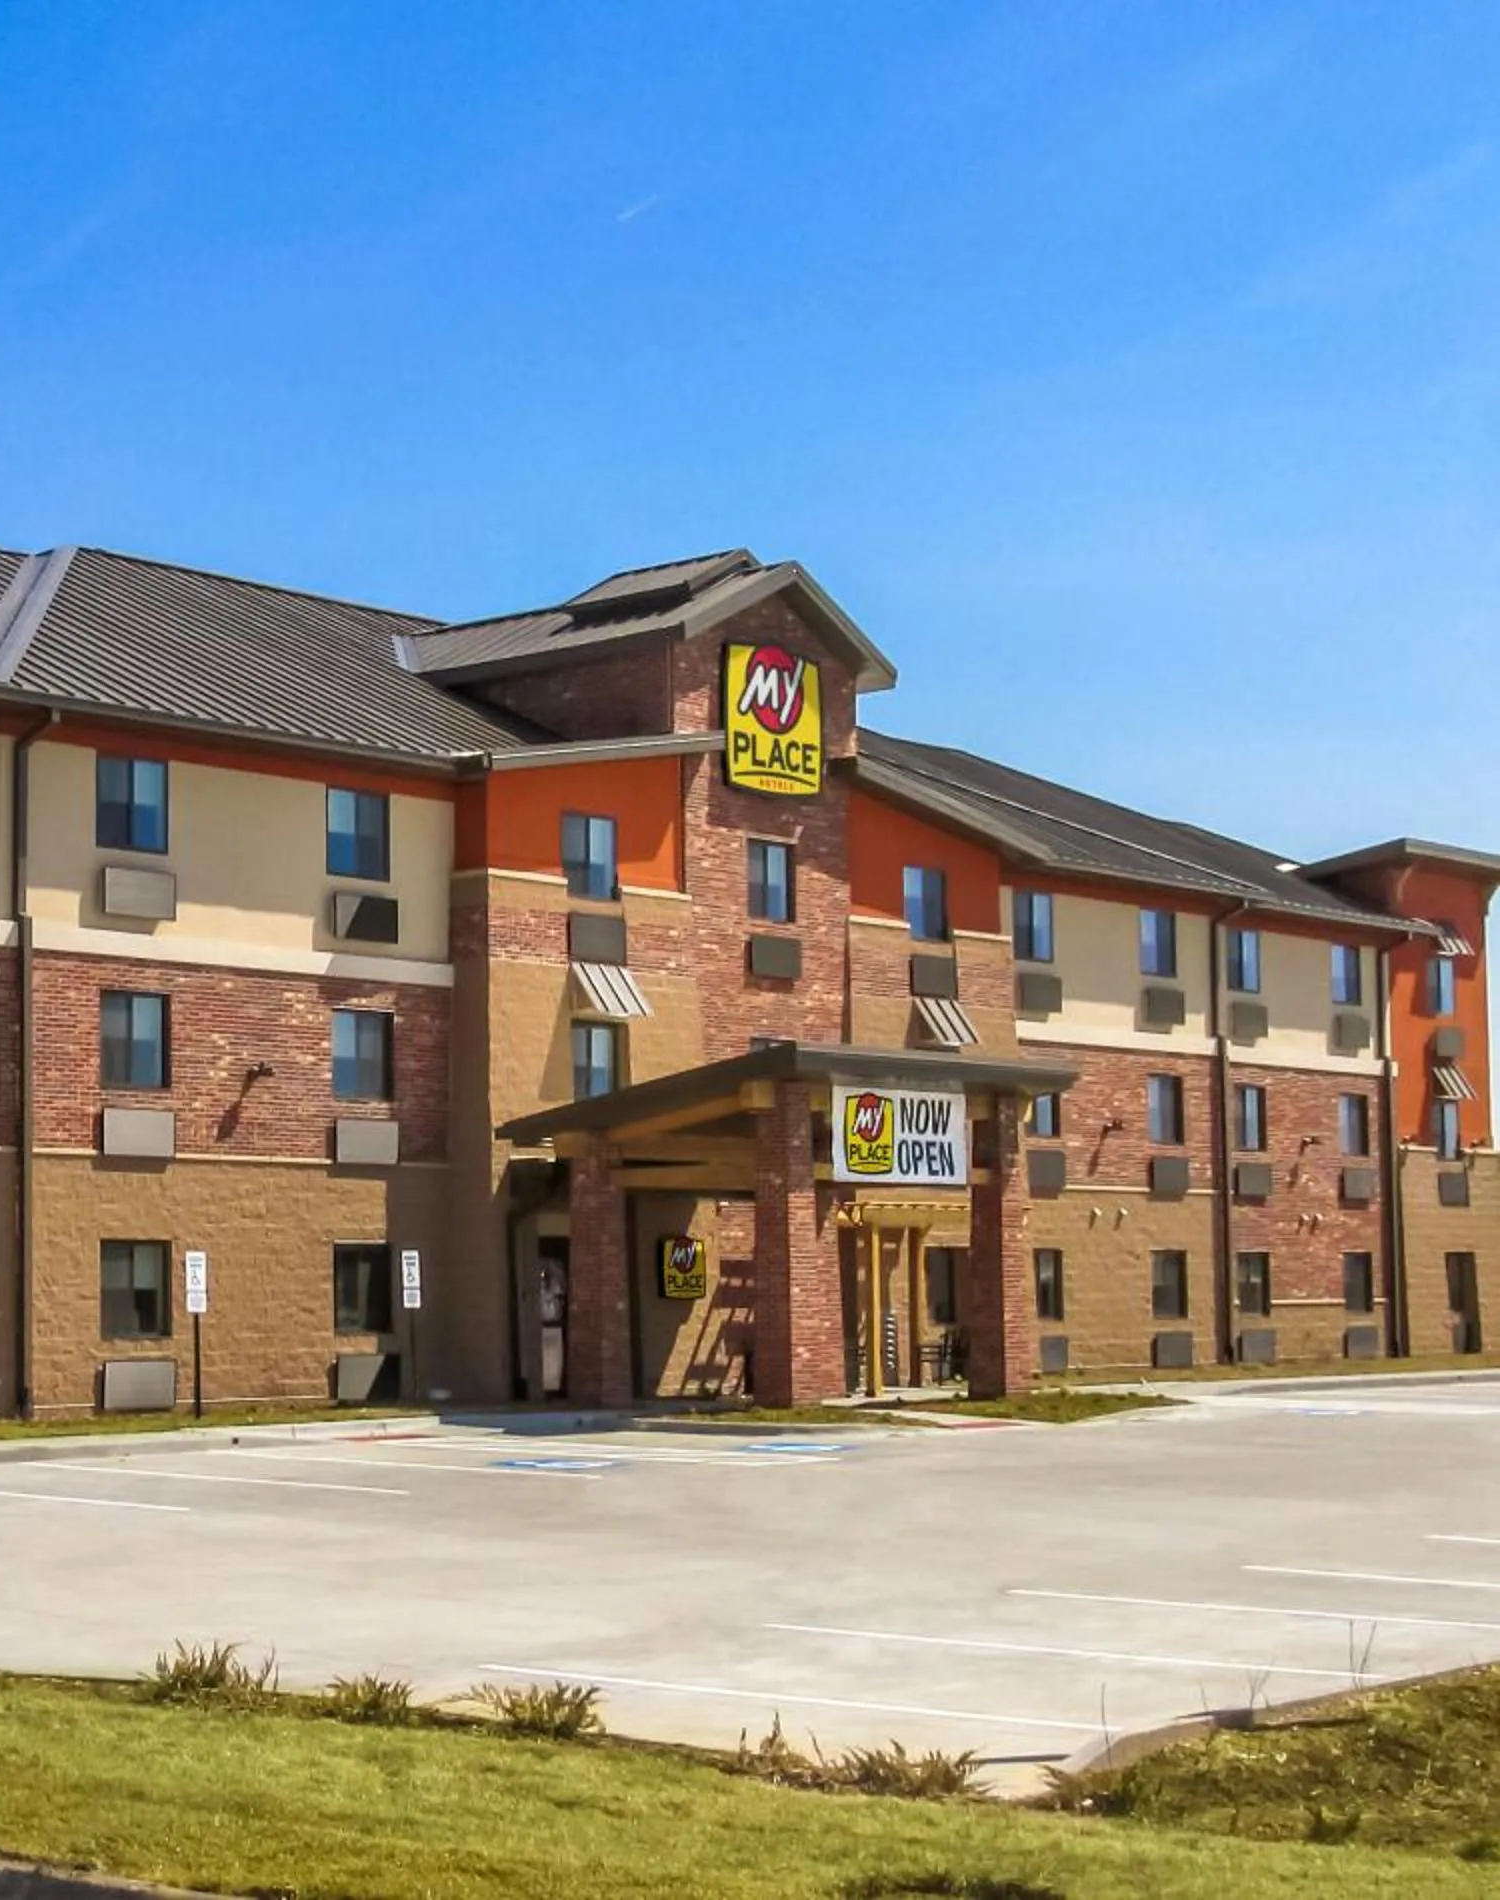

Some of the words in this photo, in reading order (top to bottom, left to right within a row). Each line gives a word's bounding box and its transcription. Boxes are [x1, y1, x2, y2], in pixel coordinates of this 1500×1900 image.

[740, 658, 804, 724] MY
[734, 731, 817, 774] PLACE
[853, 1099, 885, 1137] MY
[900, 1097, 952, 1135] NOW
[850, 1143, 891, 1161] PLACE
[898, 1139, 955, 1177] OPEN
[669, 1240, 697, 1269] MY
[667, 1275, 702, 1289] PLACE
